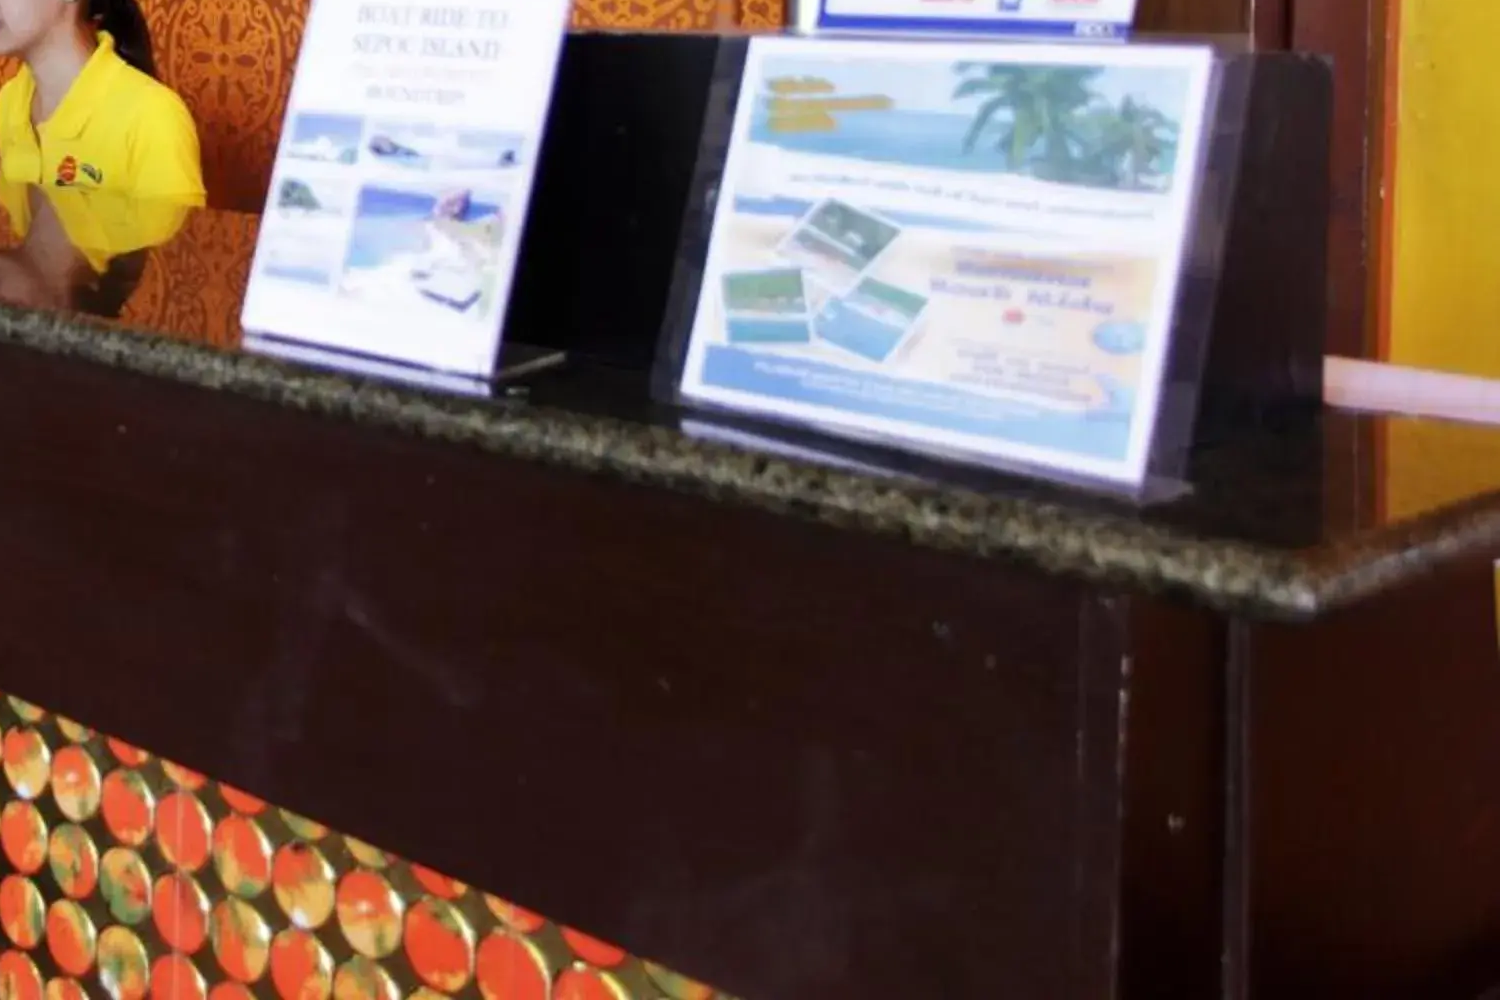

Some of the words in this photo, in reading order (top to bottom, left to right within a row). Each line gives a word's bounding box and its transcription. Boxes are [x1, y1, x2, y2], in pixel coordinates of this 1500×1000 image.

[357, 3, 412, 26] BOAT
[419, 5, 470, 28] RIDE
[477, 8, 511, 29] TO
[422, 36, 501, 61] ISLAND
